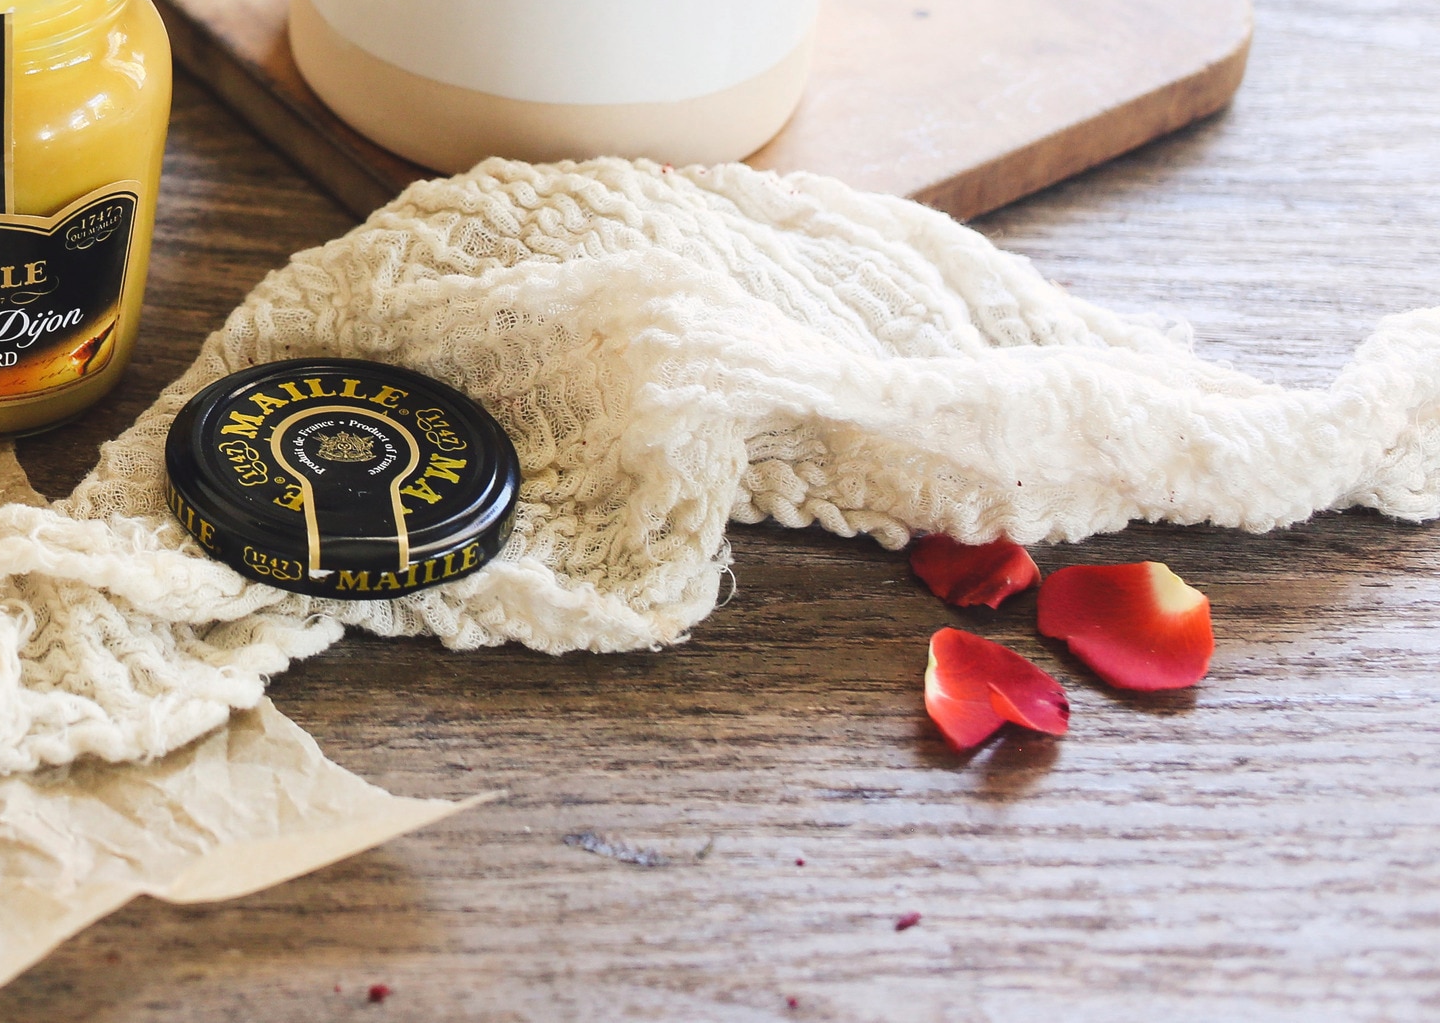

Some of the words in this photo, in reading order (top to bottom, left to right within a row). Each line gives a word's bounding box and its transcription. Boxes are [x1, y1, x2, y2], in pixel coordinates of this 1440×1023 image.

[82, 205, 114, 230] 1747
[220, 378, 409, 439] MAILLE
[292, 436, 306, 446] de
[298, 420, 335, 437] France
[348, 419, 390, 443] Product
[425, 413, 460, 445] 1747
[294, 447, 326, 475] Produit
[384, 443, 398, 454] of
[226, 447, 259, 480] 1747
[367, 453, 397, 476] France
[400, 453, 468, 515] MA
[252, 550, 290, 571] 1747
[335, 541, 480, 591] MAILLE
